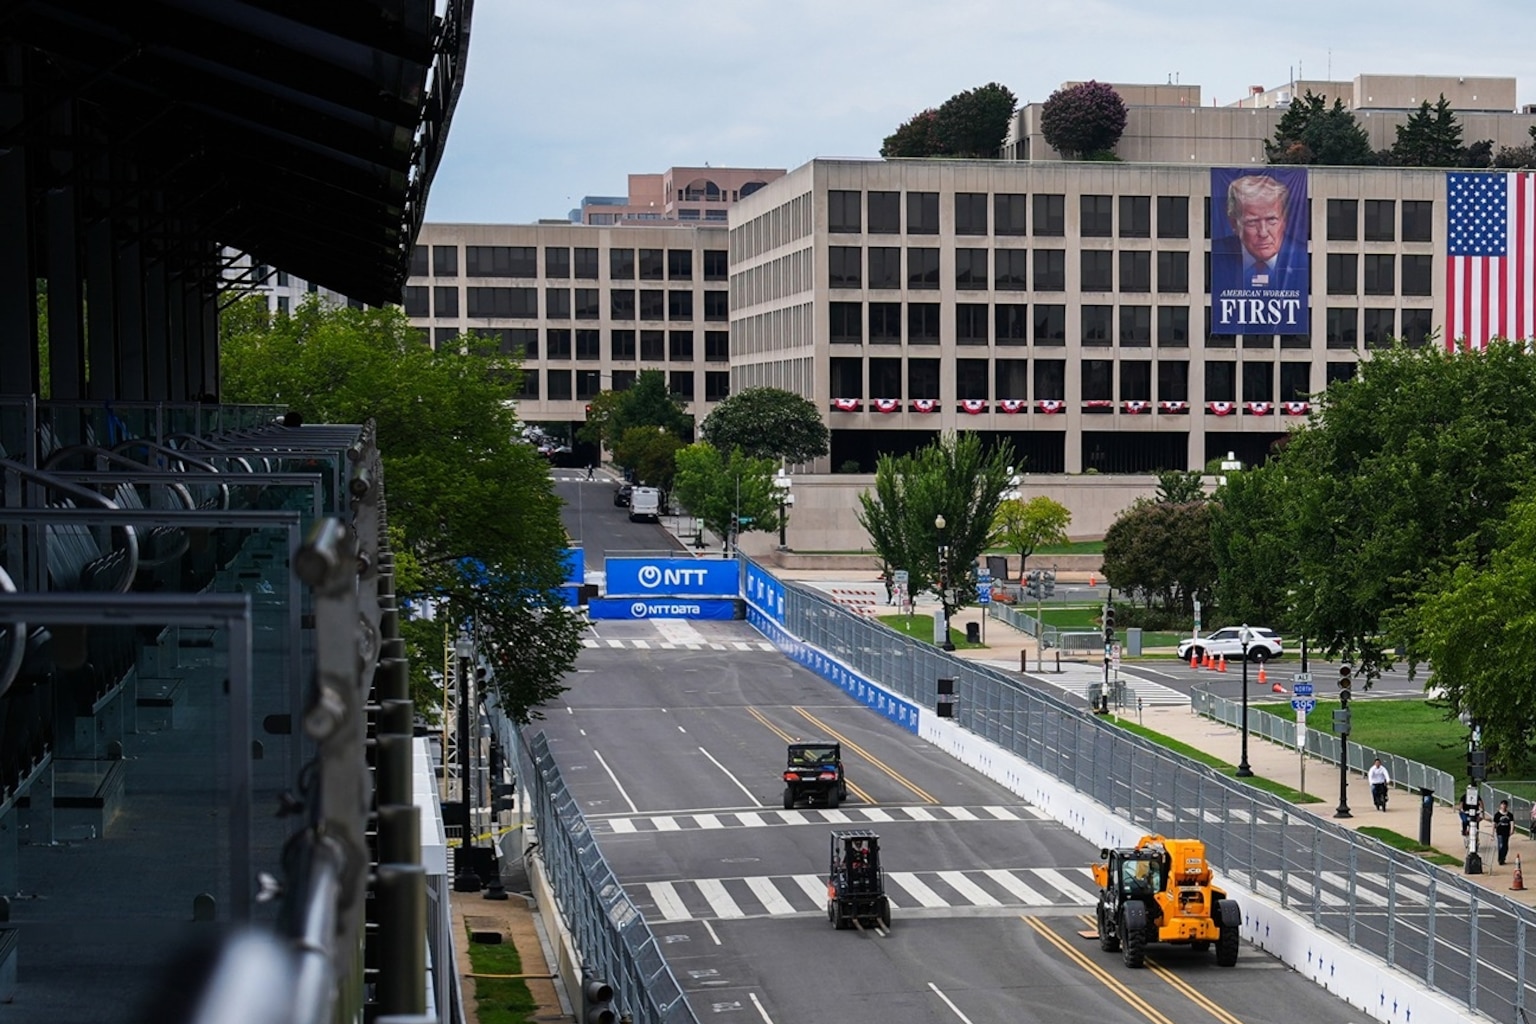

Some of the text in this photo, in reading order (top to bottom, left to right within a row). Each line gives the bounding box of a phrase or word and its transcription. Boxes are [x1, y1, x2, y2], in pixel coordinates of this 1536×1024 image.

[1220, 289, 1300, 298] AMERICAN WORKERS
[1220, 299, 1300, 325] FIRST
[664, 568, 708, 586] NTT
[648, 604, 701, 615] NTT DATA
[1294, 685, 1312, 694] NORTH
[1294, 701, 1313, 712] 395
